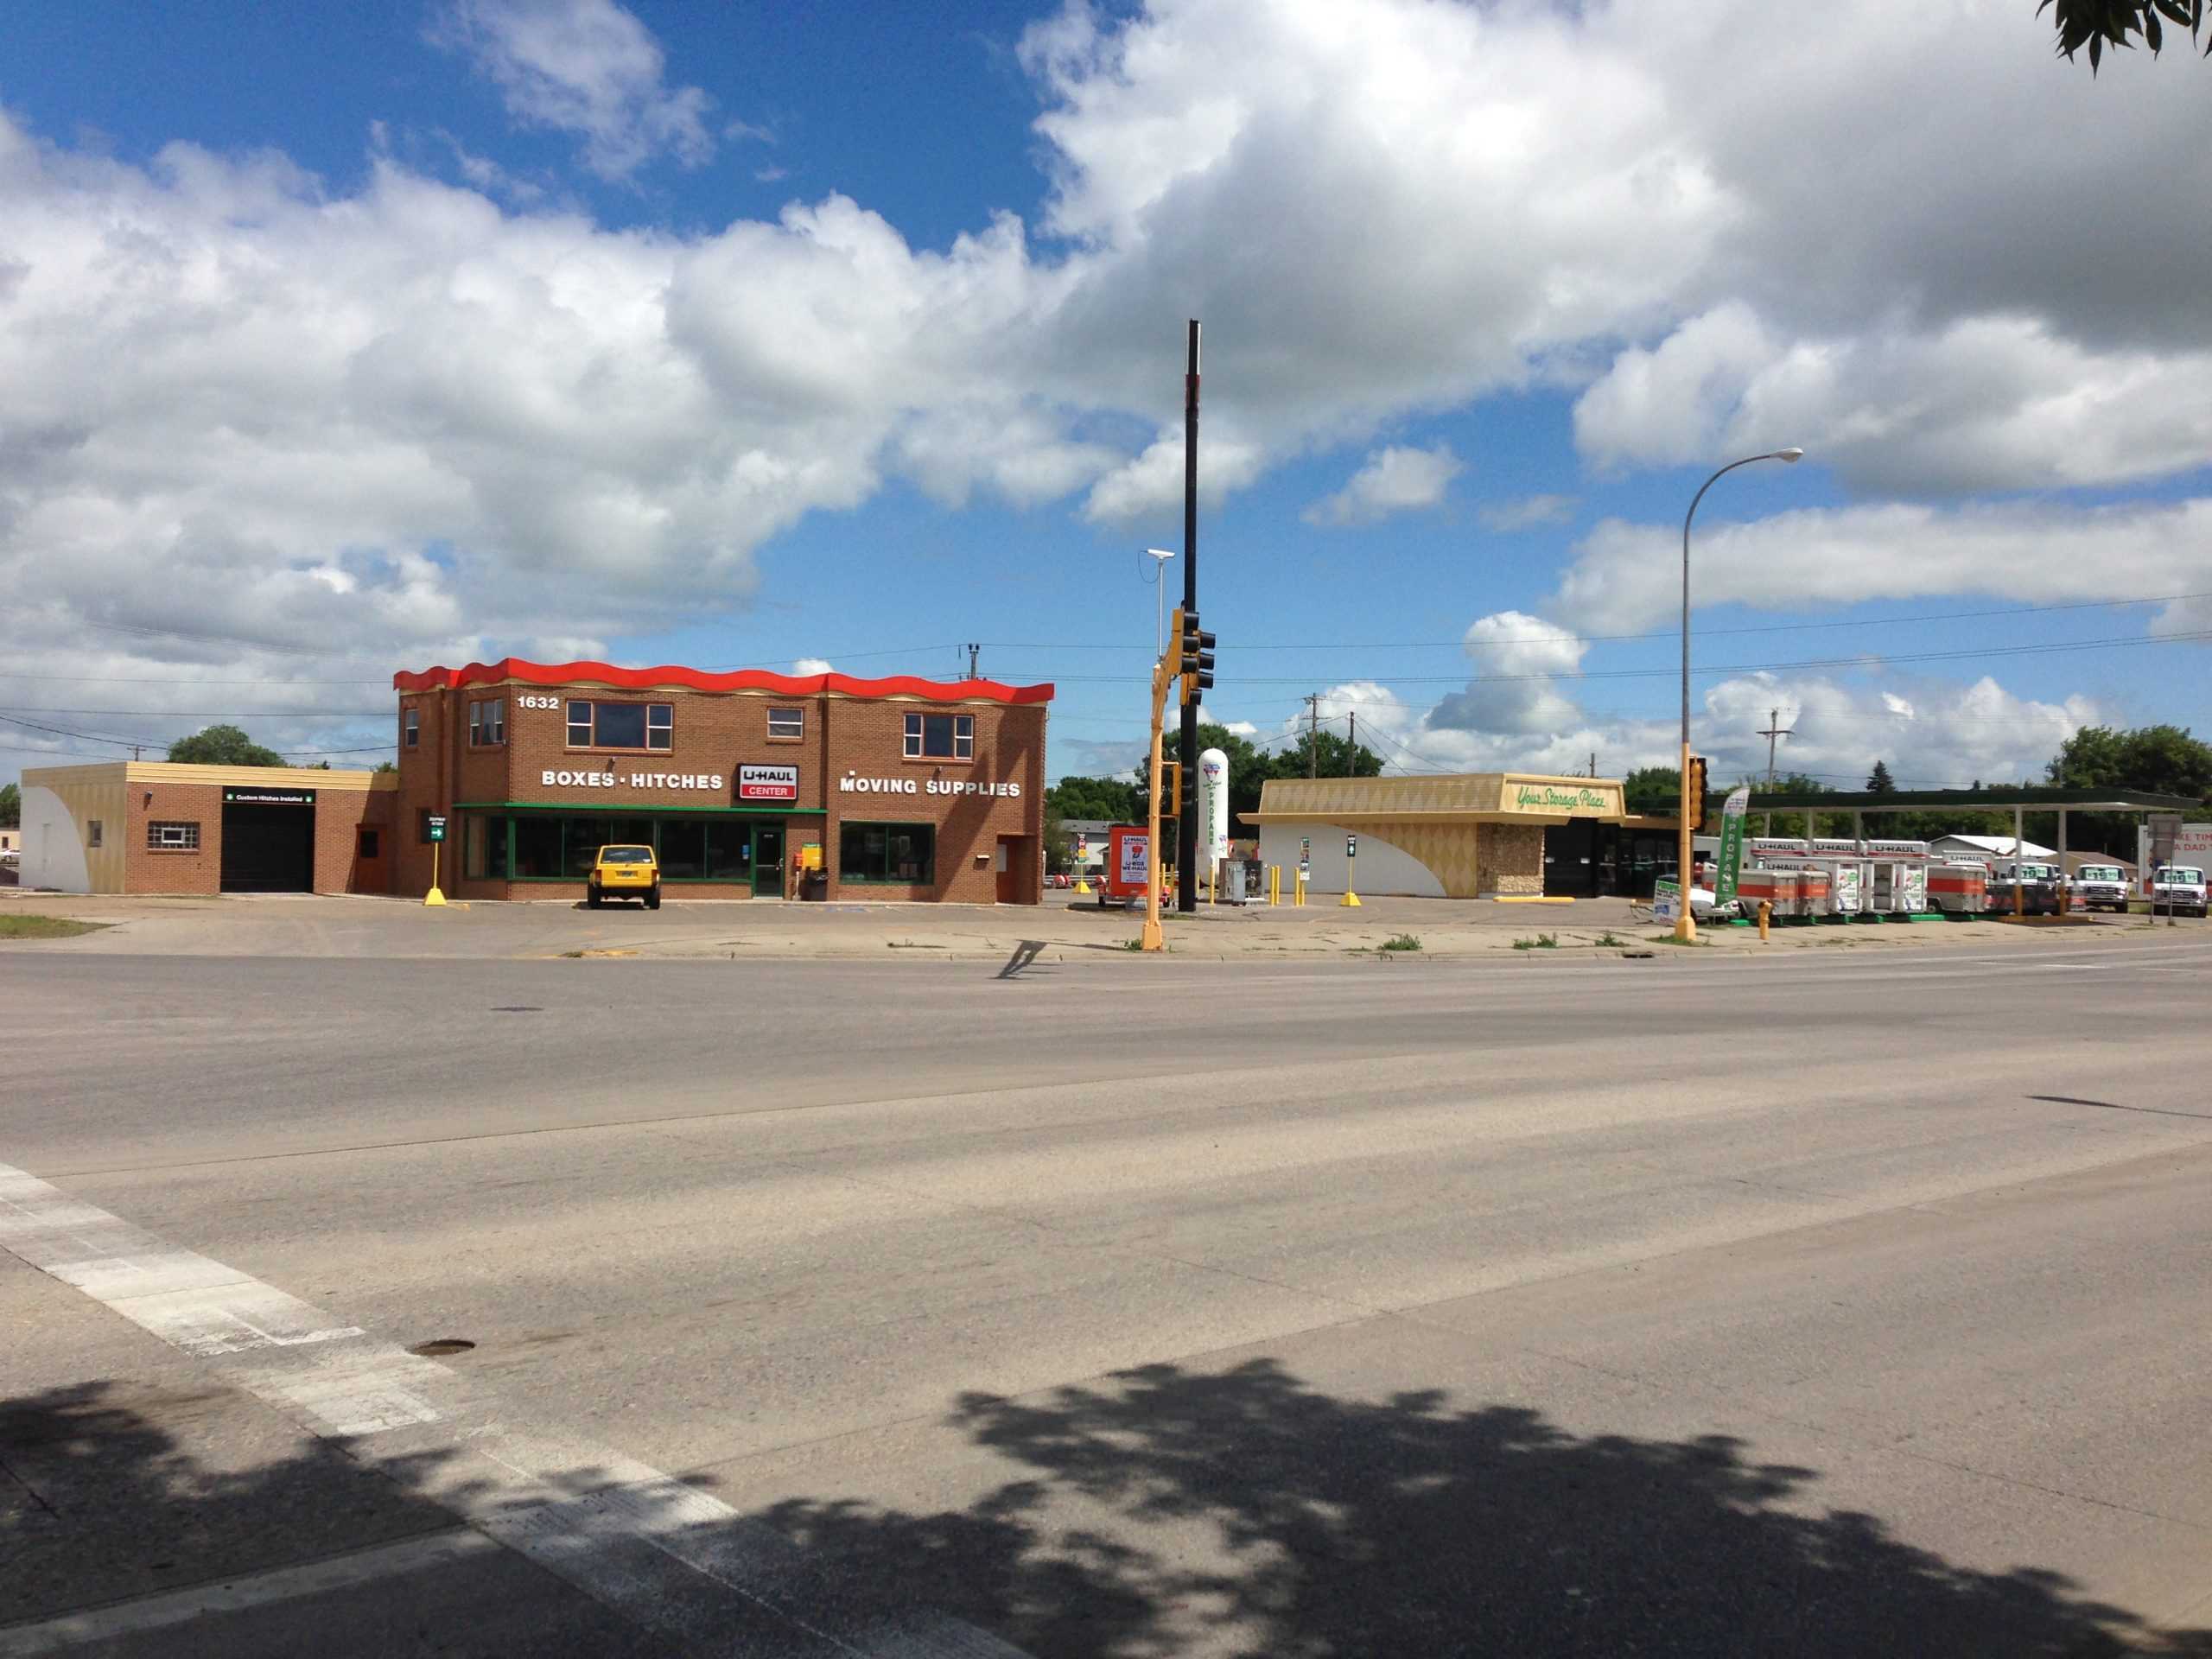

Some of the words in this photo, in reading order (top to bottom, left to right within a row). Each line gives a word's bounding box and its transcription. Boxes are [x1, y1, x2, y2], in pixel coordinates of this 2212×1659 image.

[518, 696, 559, 709] 1632
[542, 771, 614, 786] BOXES
[632, 773, 722, 789] HITCHES
[743, 770, 793, 781] U-HAUL
[748, 786, 788, 796] CENTER
[840, 778, 917, 794] MOVING
[925, 780, 1020, 797] SUPPLIES
[1518, 786, 1541, 809] Your
[1542, 787, 1579, 810] Storage
[1580, 789, 1605, 808] Place
[1722, 823, 1737, 892] PROPANE
